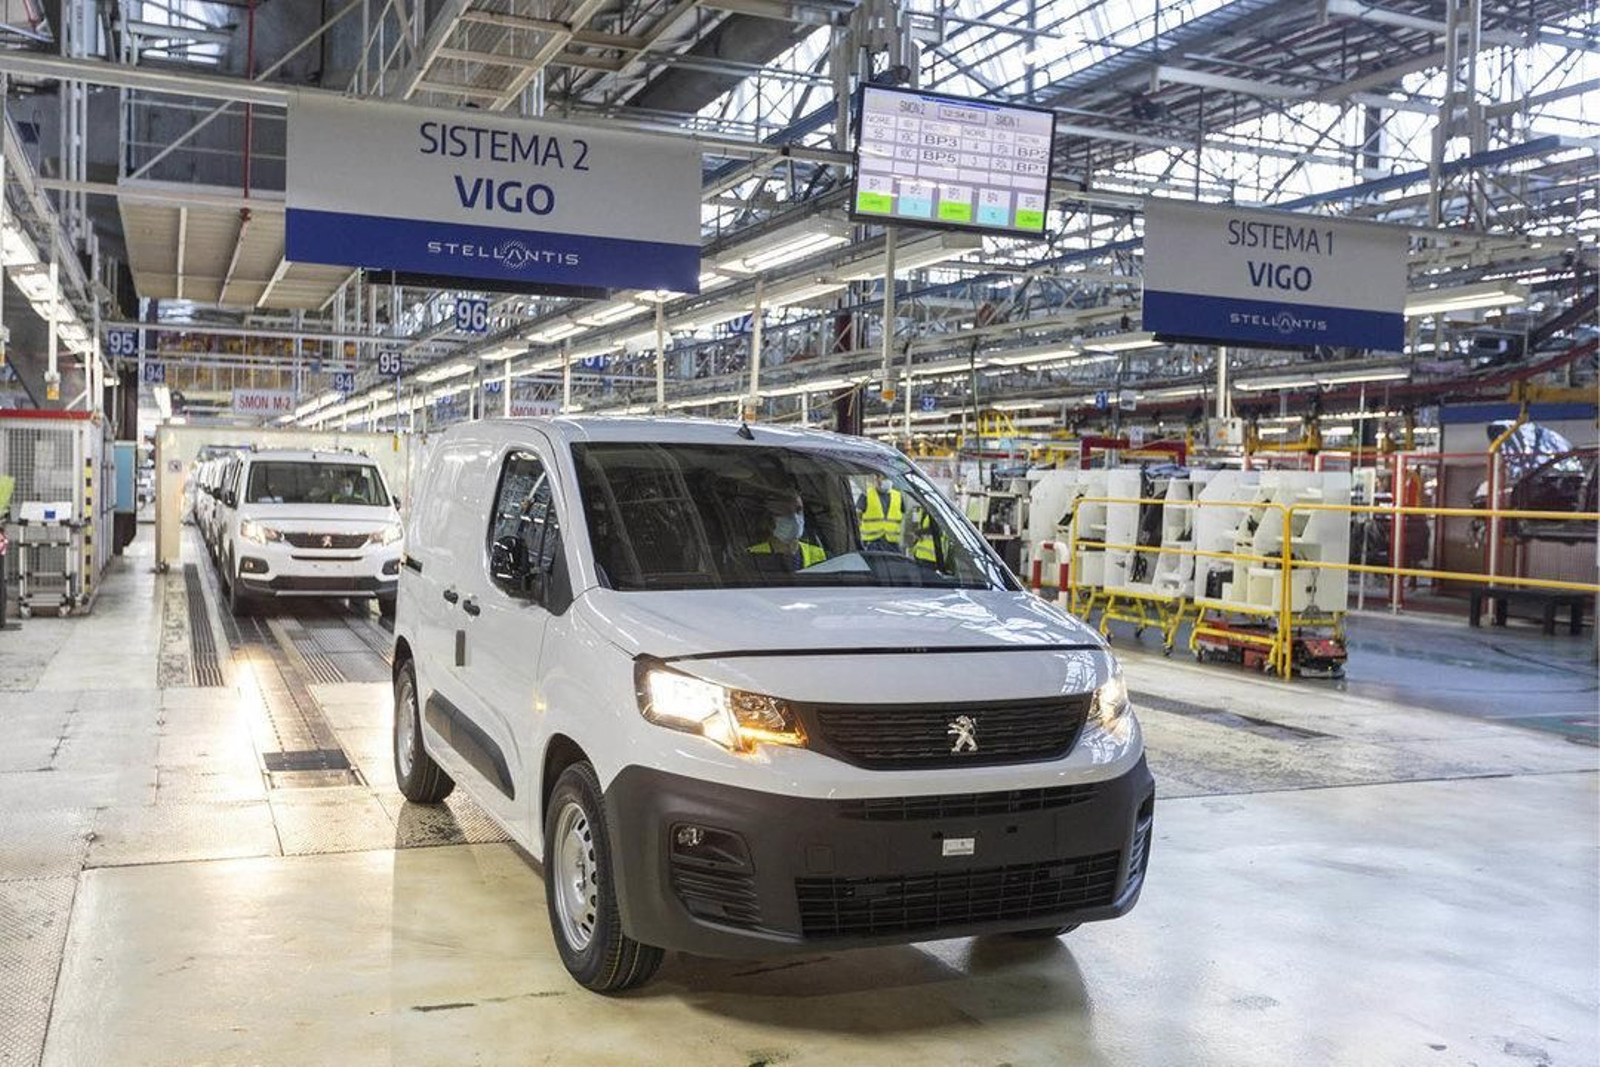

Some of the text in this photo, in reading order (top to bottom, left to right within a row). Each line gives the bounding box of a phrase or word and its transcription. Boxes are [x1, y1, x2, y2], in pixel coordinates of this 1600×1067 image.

[420, 121, 590, 171] SISTEMA 2
[925, 135, 957, 147] BP3
[923, 150, 957, 163] BP5
[1017, 147, 1049, 159] BP2
[1016, 162, 1047, 173] BP1
[454, 175, 556, 216] VIGO
[1228, 219, 1334, 256] SISTEMA 1
[427, 240, 580, 269] STELLANTIS
[1247, 261, 1313, 292] VIGO
[458, 301, 485, 330] 96
[1230, 312, 1328, 332] STELLANTIS
[146, 365, 163, 381] 94
[380, 353, 400, 373] 95
[336, 374, 352, 390] 94
[240, 396, 269, 410] SMON
